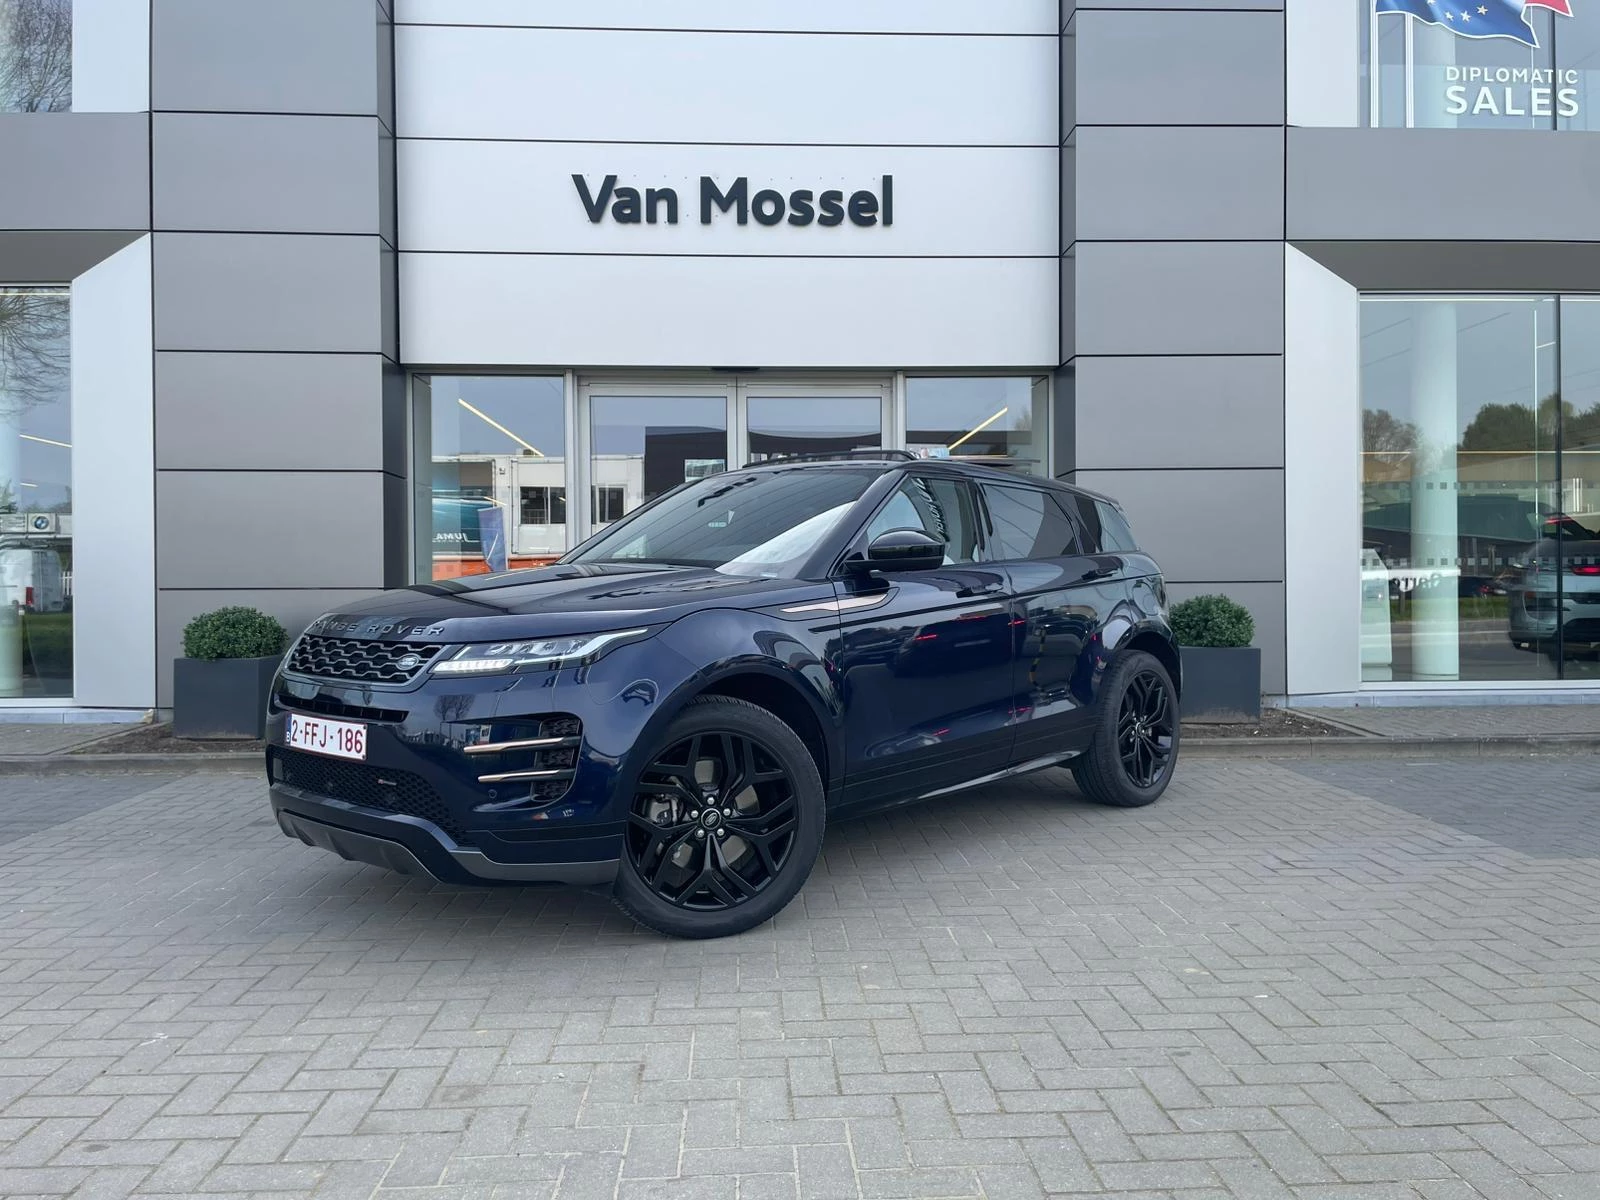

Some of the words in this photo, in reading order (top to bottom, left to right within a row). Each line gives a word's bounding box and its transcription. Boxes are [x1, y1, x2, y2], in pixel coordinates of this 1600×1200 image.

[1446, 66, 1578, 84] DIPLOMATIC
[1446, 85, 1579, 117] SALES
[571, 174, 678, 224] Van
[700, 175, 893, 226] Mossel
[366, 624, 445, 636] ROVER
